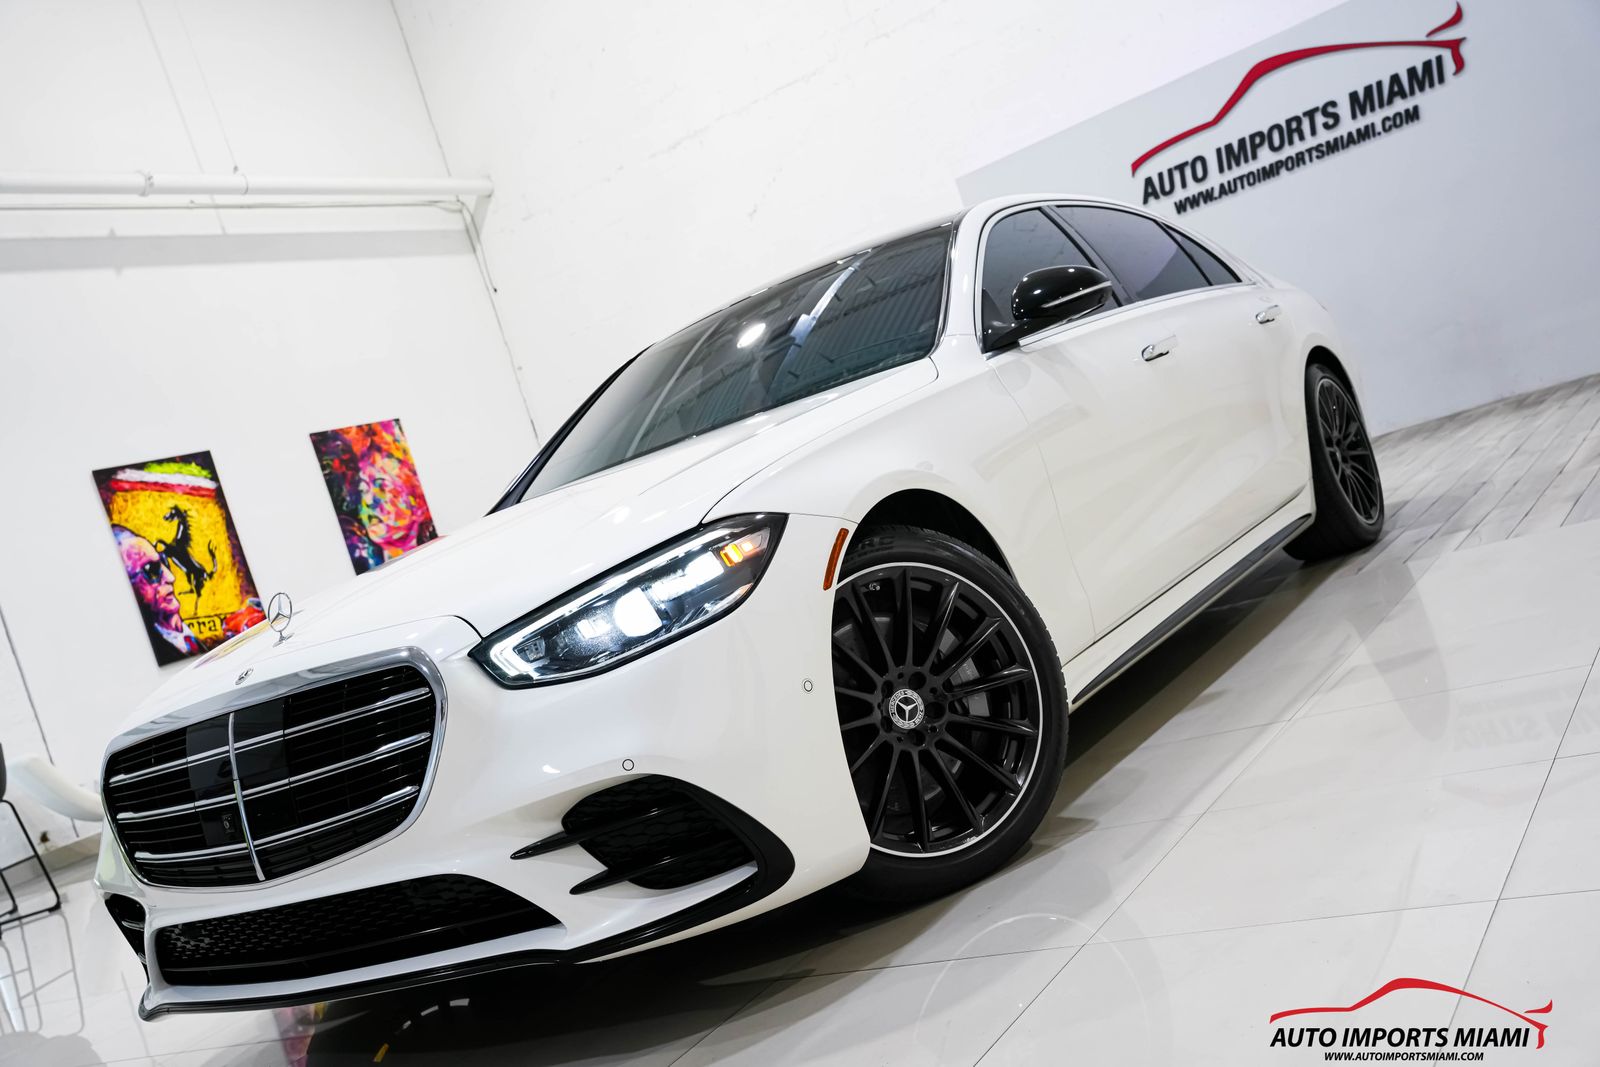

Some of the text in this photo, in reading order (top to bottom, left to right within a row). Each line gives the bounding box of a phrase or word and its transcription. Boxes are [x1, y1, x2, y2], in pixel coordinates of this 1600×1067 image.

[1142, 55, 1446, 205] AUTO IMPORTS MIAMI
[1174, 105, 1421, 215] WWW.AUTOIMPORTSMIAMI.COM
